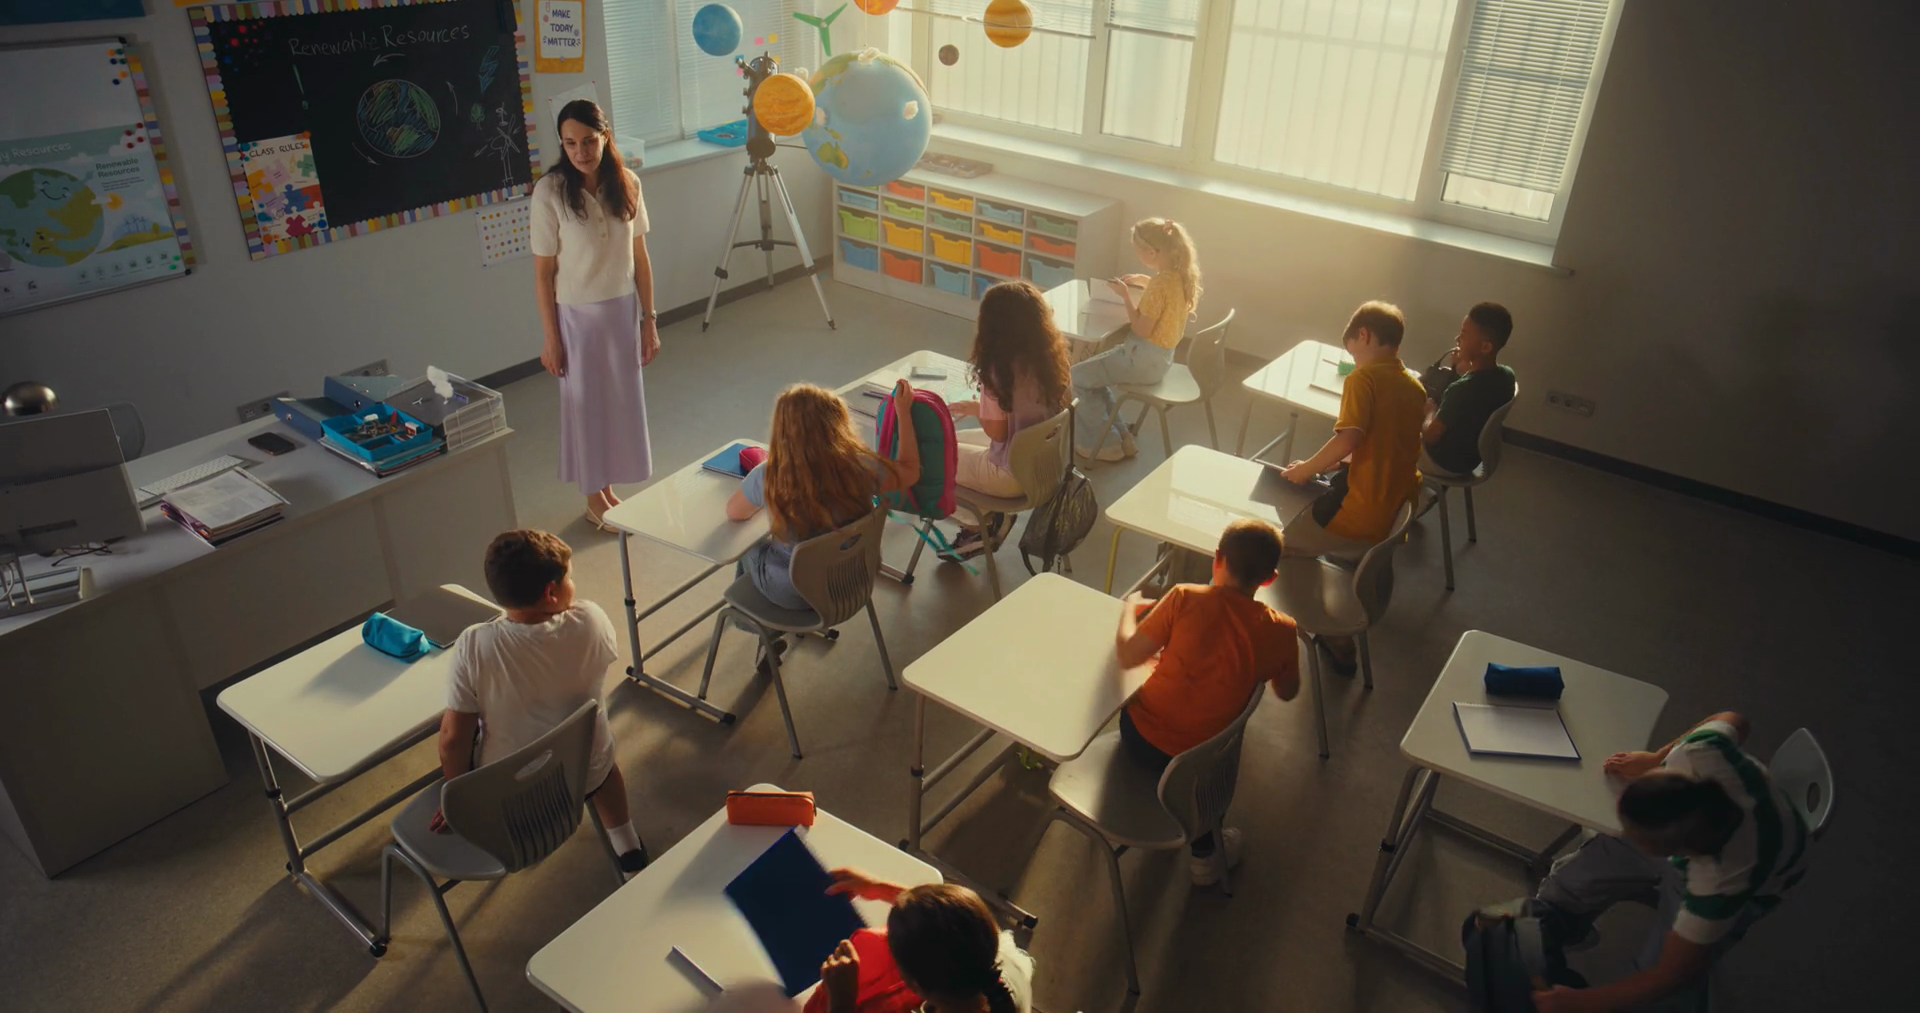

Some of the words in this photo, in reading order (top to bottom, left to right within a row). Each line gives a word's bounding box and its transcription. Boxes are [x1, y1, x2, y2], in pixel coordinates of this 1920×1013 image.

[551, 9, 571, 19] MAKE
[550, 23, 574, 33] TODAY
[288, 31, 380, 56] Renewable
[380, 24, 470, 48] Resources
[547, 37, 576, 47] MATTER
[11, 142, 72, 159] Resources
[249, 147, 275, 158] CLASS
[278, 142, 305, 153] RULES
[95, 157, 139, 171] Renewable
[97, 166, 140, 179] Resources
